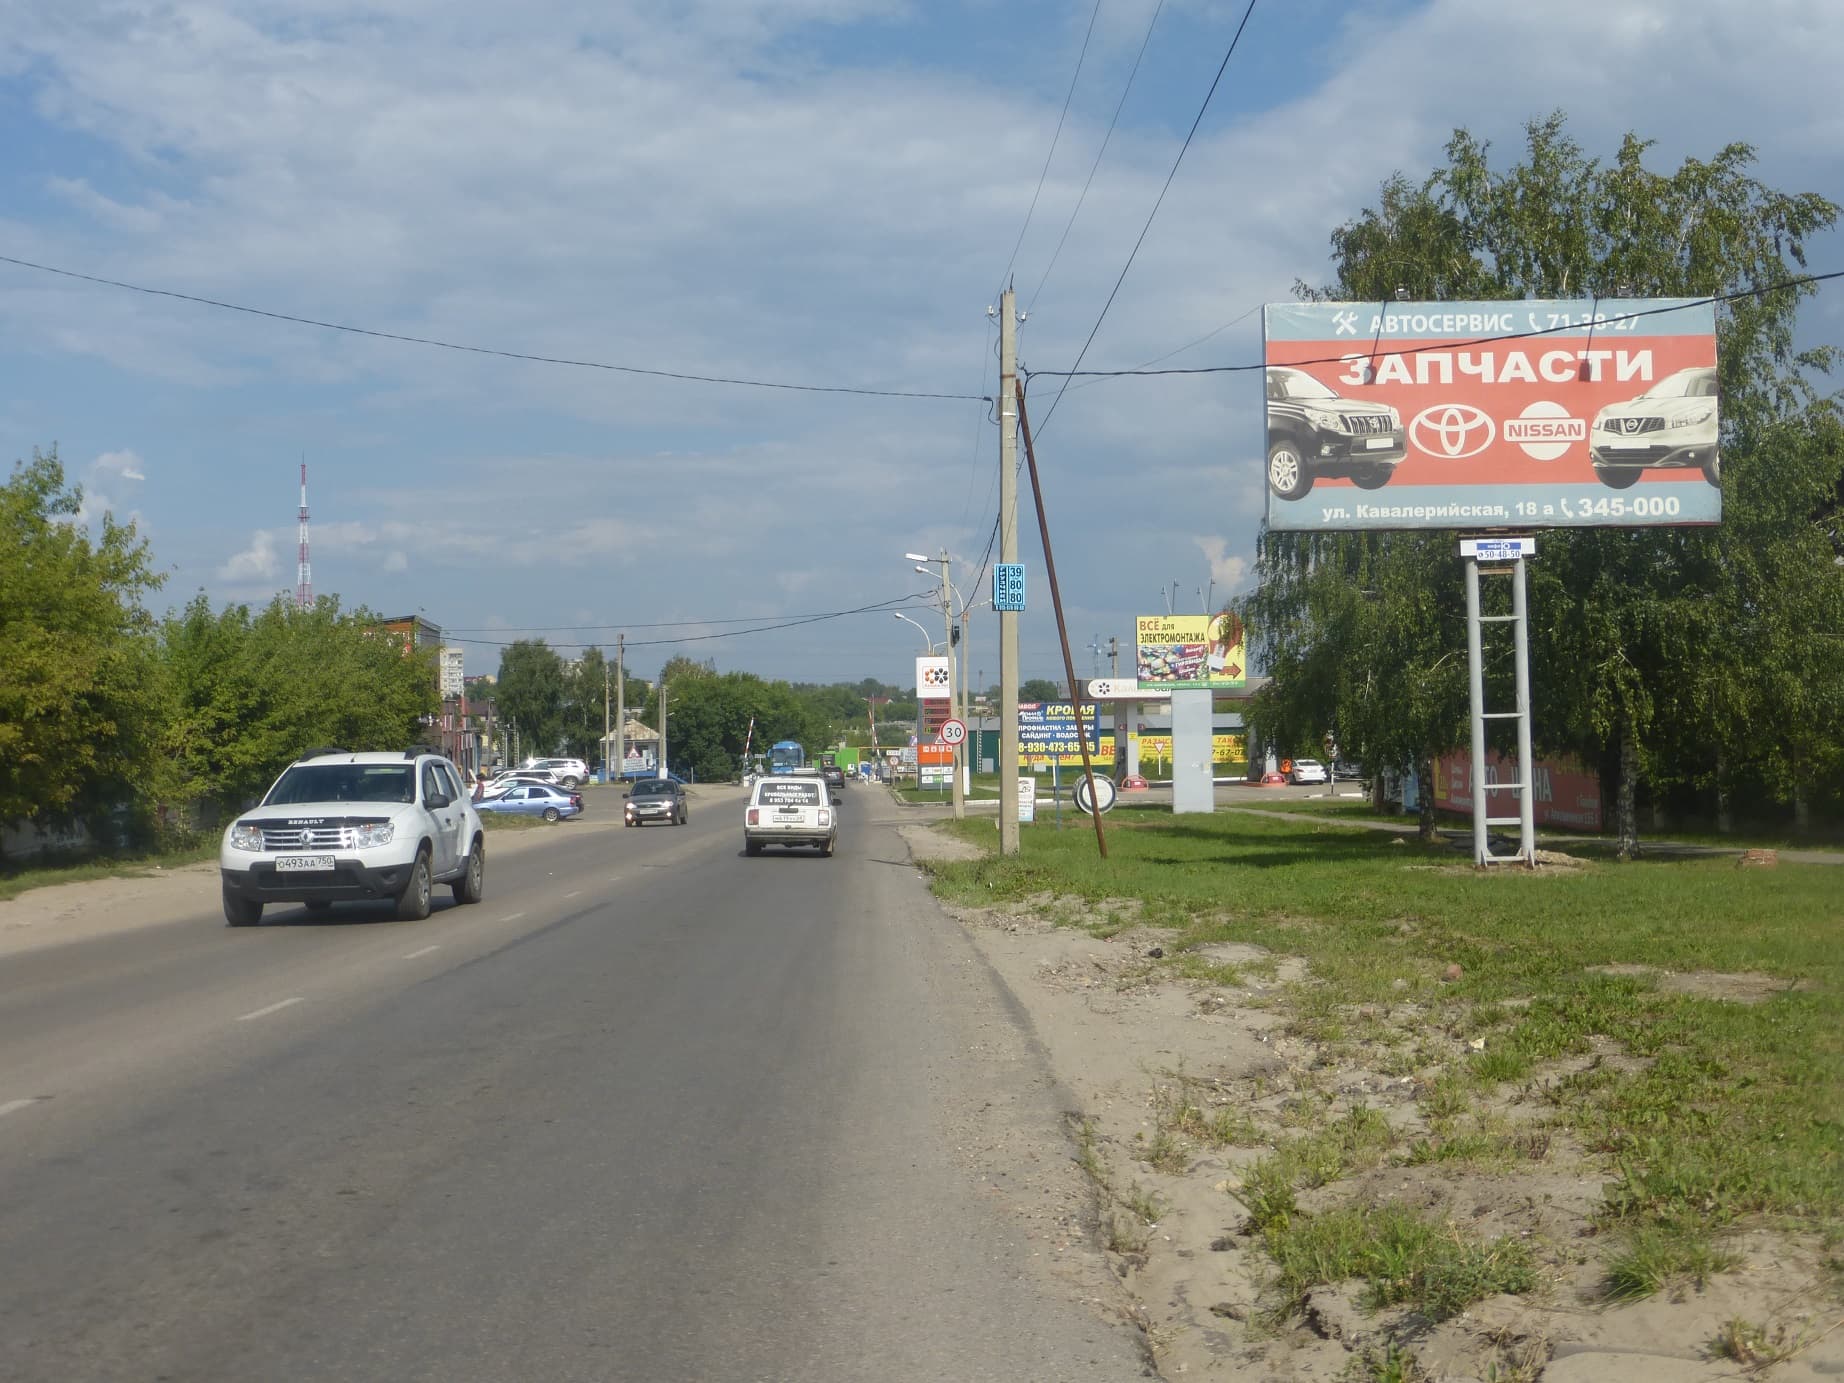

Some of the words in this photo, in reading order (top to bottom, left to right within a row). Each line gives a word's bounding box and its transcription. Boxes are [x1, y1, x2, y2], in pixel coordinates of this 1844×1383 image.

[1369, 313, 1514, 334] АВТОСЕРВИС
[1338, 349, 1653, 386] ЗАПЧАСТИ
[1508, 423, 1582, 437] NISSAN
[1322, 507, 1350, 522] ул.
[1356, 502, 1509, 520] Кавалерийская,
[1515, 501, 1537, 516] 18
[1543, 504, 1554, 516] а
[1578, 496, 1680, 518] 345-000
[1010, 567, 1022, 577] 39
[1010, 580, 1022, 590] 80
[1010, 593, 1022, 602] 80
[1139, 618, 1160, 631] ВСЁ
[1140, 633, 1205, 643] ЭЛЕКТРОМОНТАЖА
[946, 727, 962, 738] 30
